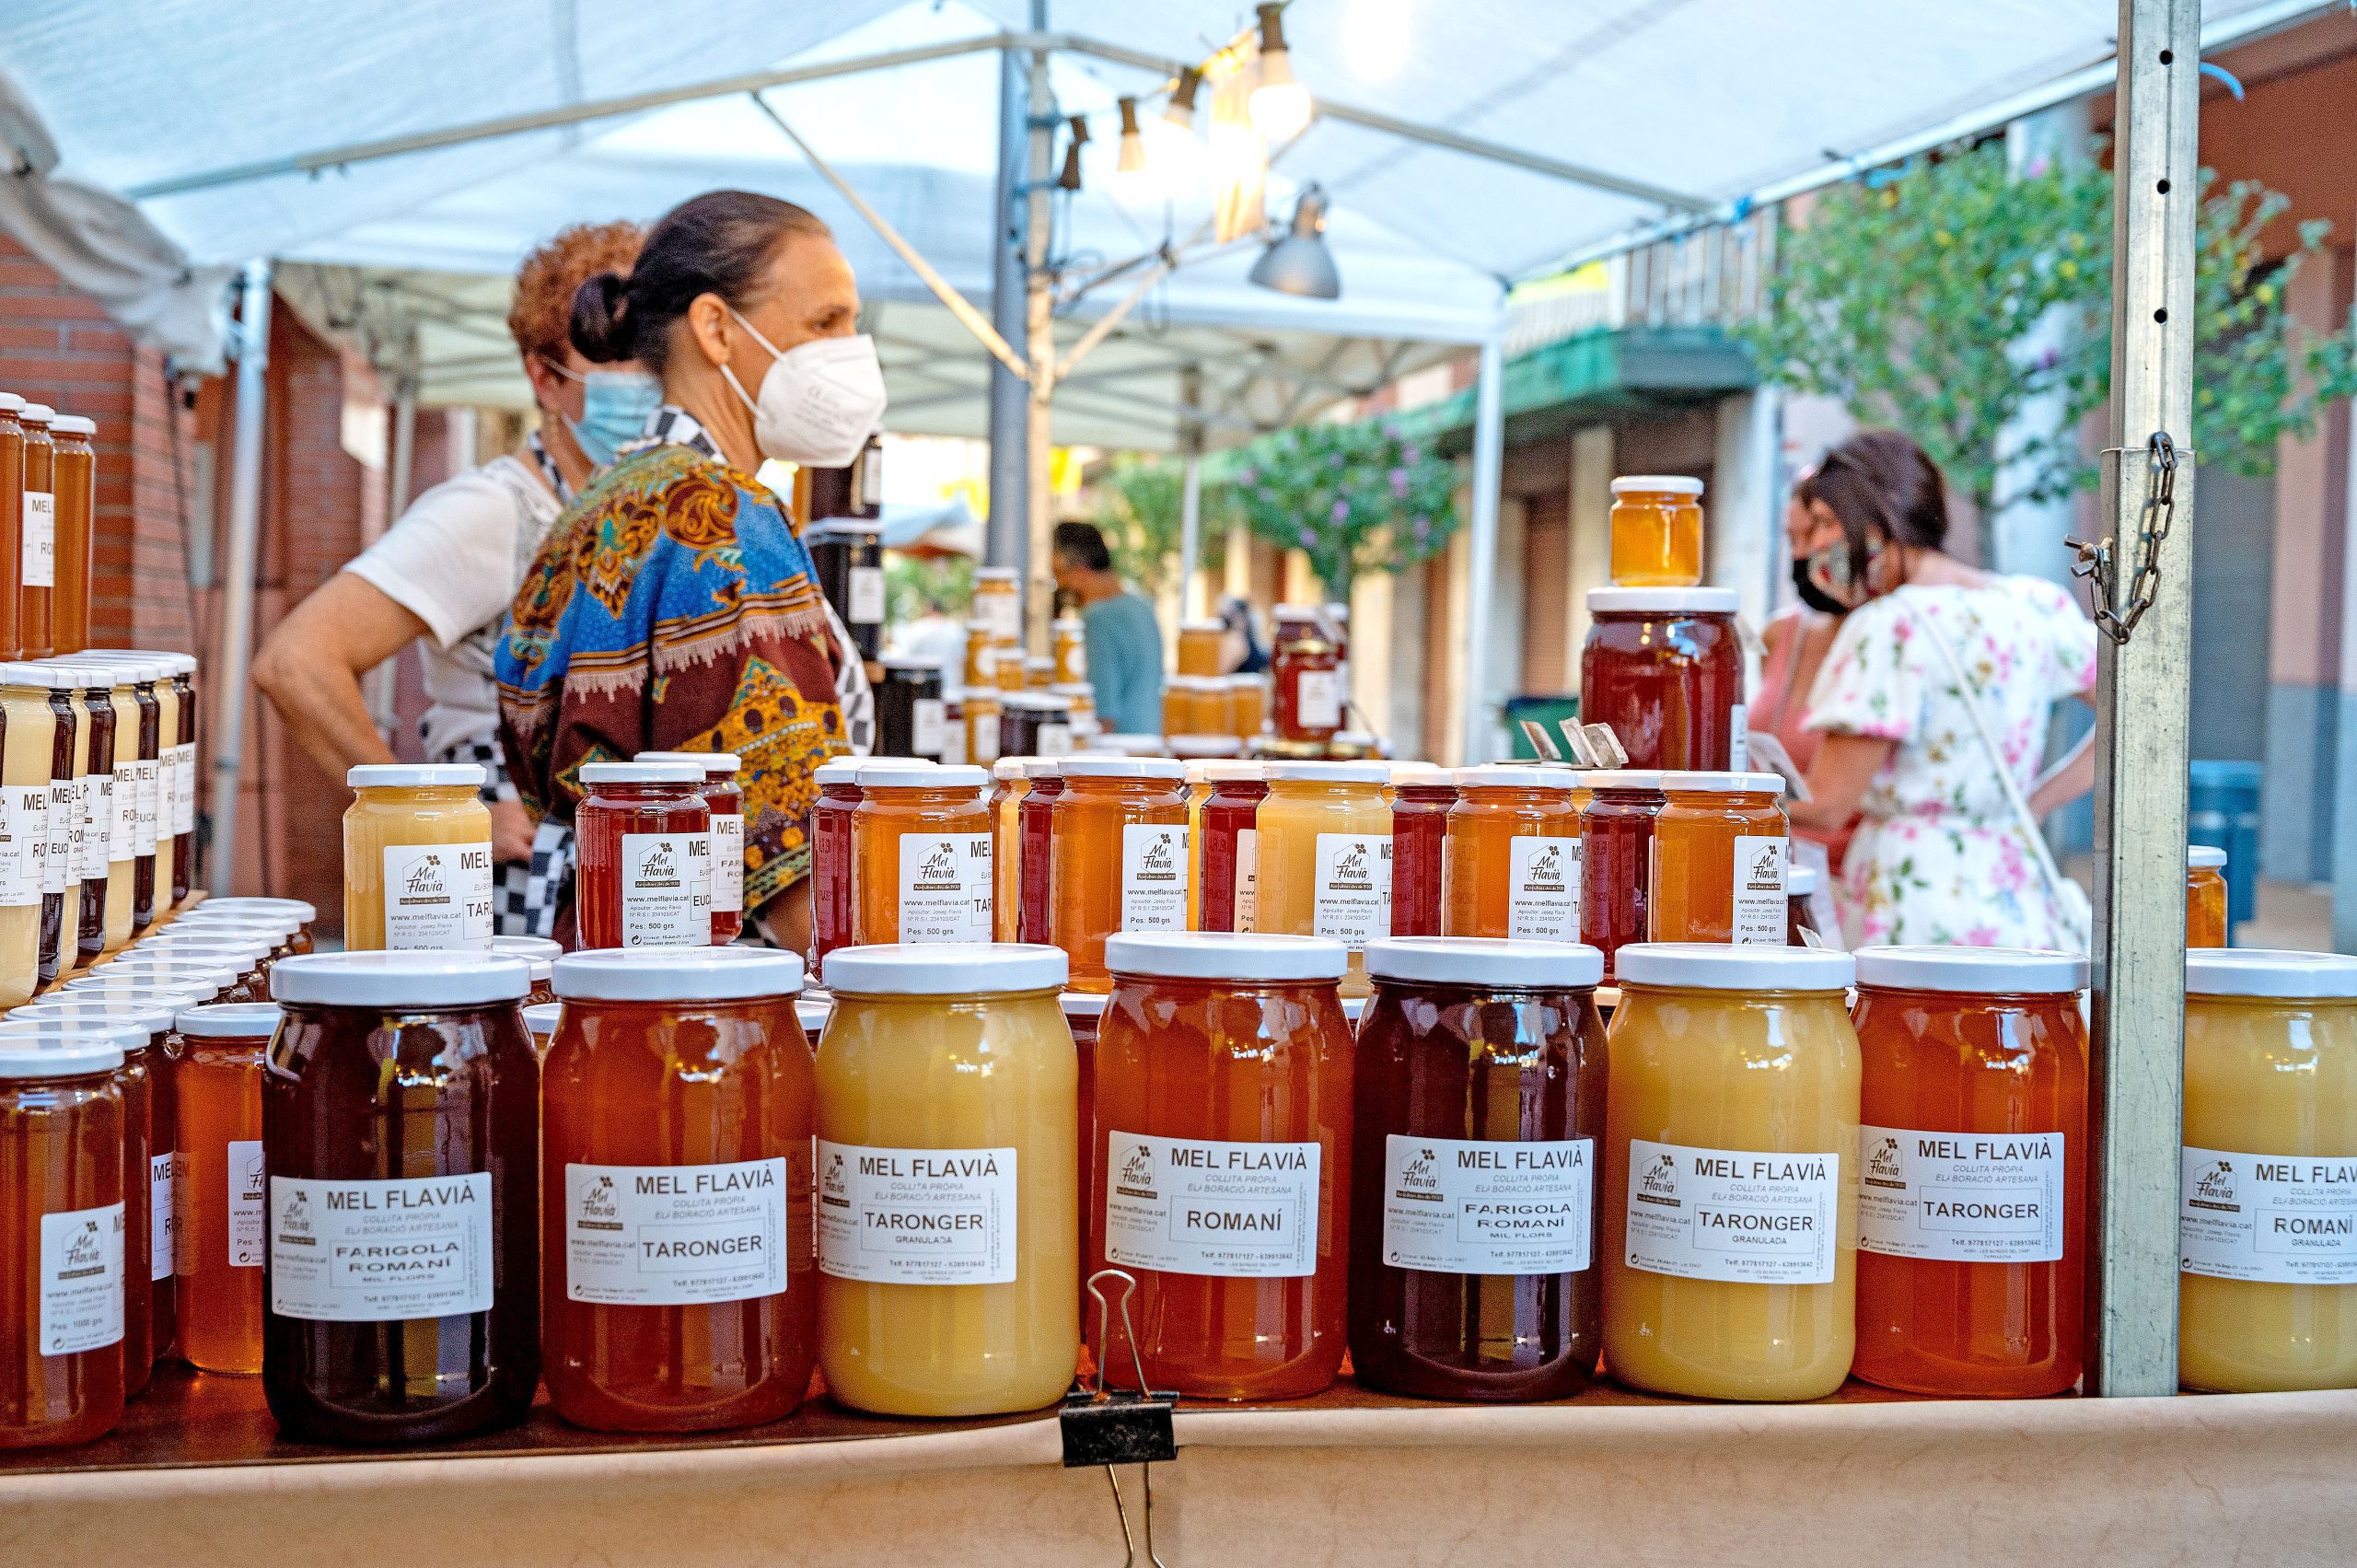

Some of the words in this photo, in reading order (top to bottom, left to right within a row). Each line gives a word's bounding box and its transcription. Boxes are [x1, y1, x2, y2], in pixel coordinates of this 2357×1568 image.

[32, 499, 51, 512] MEL
[160, 755, 175, 766] MEL
[178, 751, 193, 763] MEL
[114, 769, 134, 782] MEL
[52, 787, 71, 803] MEL
[24, 795, 47, 810] MEL
[717, 822, 738, 834] MEL
[33, 843, 47, 857] RO
[971, 841, 991, 857] MEL
[1149, 844, 1167, 857] Mel
[461, 851, 488, 869] MEL
[648, 854, 668, 865] Mel
[927, 854, 948, 866] Mel
[1144, 855, 1171, 868] Flavià
[1342, 854, 1362, 866] Mel
[1537, 856, 1555, 868] Mel
[1759, 855, 1774, 867] Mel
[413, 866, 435, 880] Mel
[642, 865, 674, 877] Flavià
[921, 865, 955, 879] Flavià
[1337, 865, 1367, 878] Flavià
[1531, 867, 1560, 880] Flavià
[1754, 865, 1777, 878] Flavià
[406, 879, 443, 893] Flavià
[627, 894, 689, 903] www.melflavia.cat
[694, 895, 711, 906] EUC
[904, 899, 970, 907] www.melflavia.cat
[1319, 898, 1378, 906] www.melflavia.cat
[390, 912, 460, 921] www.melflavia.cat
[1131, 916, 1145, 924] Pes:
[1161, 917, 1170, 925] grs
[664, 923, 674, 931] grs
[908, 927, 923, 935] Pes:
[927, 927, 939, 935] 500
[943, 928, 954, 936] grs
[1341, 927, 1352, 935] 500
[1354, 928, 1364, 936] grs
[1517, 926, 1534, 935] Pes:
[1550, 927, 1559, 935] grs
[1875, 1147, 1892, 1162] Mel
[1919, 1140, 1966, 1159] MEL
[1976, 1137, 2052, 1160] FLAVIÀ
[1127, 1156, 1145, 1169] Mel
[1171, 1148, 1219, 1168] MEL
[1228, 1147, 1306, 1170] FLAVIÀ
[1457, 1150, 1506, 1168] MEL
[1515, 1144, 1583, 1169] FLAVIÀ
[860, 1156, 903, 1177] MEL
[912, 1154, 999, 1178] FLAVIÀ
[1409, 1160, 1429, 1174] Mel
[1649, 1165, 1667, 1180] Mel
[1696, 1158, 1744, 1179] MEL
[1753, 1158, 1826, 1180] FLAVIÀ
[1870, 1160, 1898, 1177] Flavià
[1953, 1164, 1990, 1173] COLLITA
[636, 1176, 687, 1194] MEL
[697, 1164, 773, 1193] FLAVIÀ
[1122, 1167, 1151, 1185] Flavià
[1205, 1174, 1243, 1182] COLLITA
[1493, 1174, 1528, 1183] COLLITA
[1995, 1175, 2038, 1183] ARTESANA
[2203, 1171, 2226, 1186] Mel
[2257, 1164, 2304, 1182] MEL
[1403, 1171, 1436, 1189] Flavià
[1643, 1177, 1674, 1193] Flavià
[1248, 1186, 1292, 1194] ARTESANA
[1533, 1183, 1572, 1192] ARTESANA
[1731, 1183, 1767, 1192] COLLITA
[2197, 1181, 2233, 1199] Flavià
[327, 1191, 377, 1210] MEL
[387, 1179, 475, 1209] FLAVIÀ
[588, 1188, 609, 1202] Mel
[1772, 1195, 1812, 1203] ARTESANA
[1859, 1193, 1917, 1207] www.melflavia.cat
[1109, 1202, 1166, 1217] www.melflavia.cat
[1387, 1207, 1455, 1219] www.melflavia.cat
[1466, 1203, 1571, 1214] FARIGOLA
[1923, 1202, 2039, 1218] TARONGER
[865, 1213, 983, 1230] TARONGER
[1188, 1208, 1282, 1231] ROMANÍ
[1478, 1216, 1564, 1227] ROMANÍ
[1631, 1210, 1690, 1225] www.melflavia.cat
[1700, 1212, 1813, 1230] TARONGER
[2275, 1214, 2352, 1234] ROMANÍ
[644, 1236, 762, 1258] TARONGER
[1733, 1236, 1787, 1245] GRANULADA
[336, 1242, 459, 1257] FARIGOLA
[350, 1257, 450, 1272] ROMANÍ
